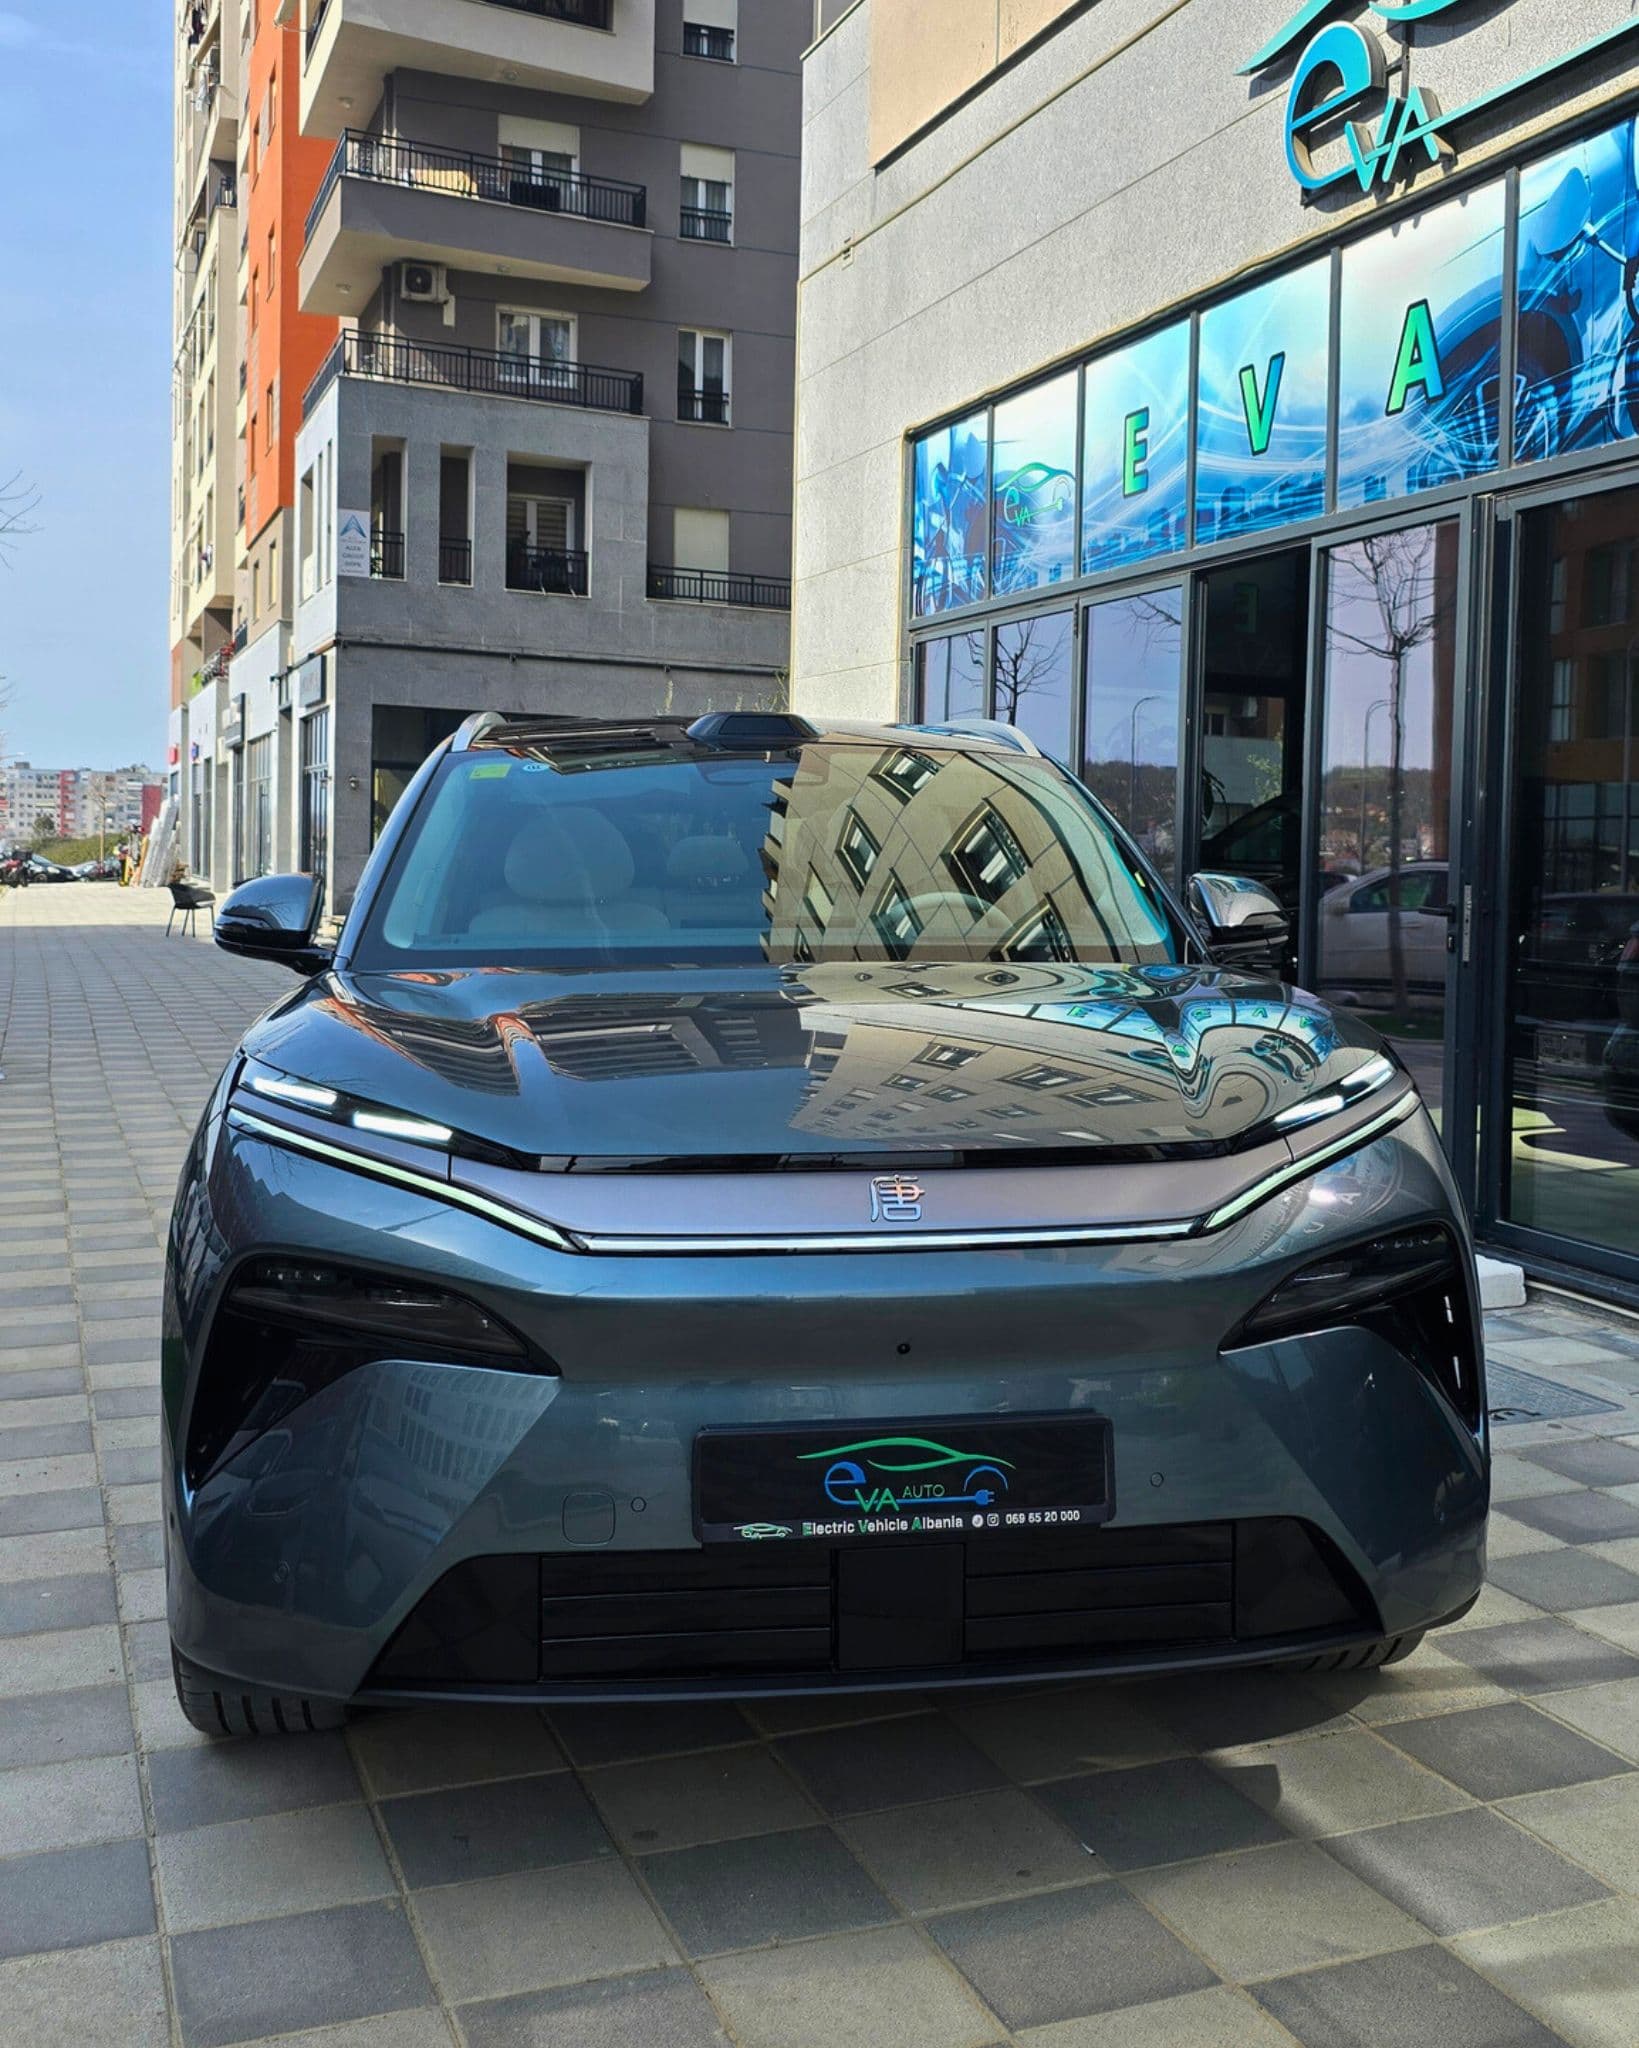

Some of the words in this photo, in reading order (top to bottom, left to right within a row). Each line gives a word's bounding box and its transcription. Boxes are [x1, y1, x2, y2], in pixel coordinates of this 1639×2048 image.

[902, 1484, 945, 1498] AUTO
[1005, 1513, 1025, 1524] 069
[1044, 1511, 1057, 1522] 20
[1060, 1510, 1080, 1521] 000
[802, 1521, 855, 1536] Electric
[858, 1517, 908, 1533] Vehicle
[912, 1515, 963, 1532] Albania
